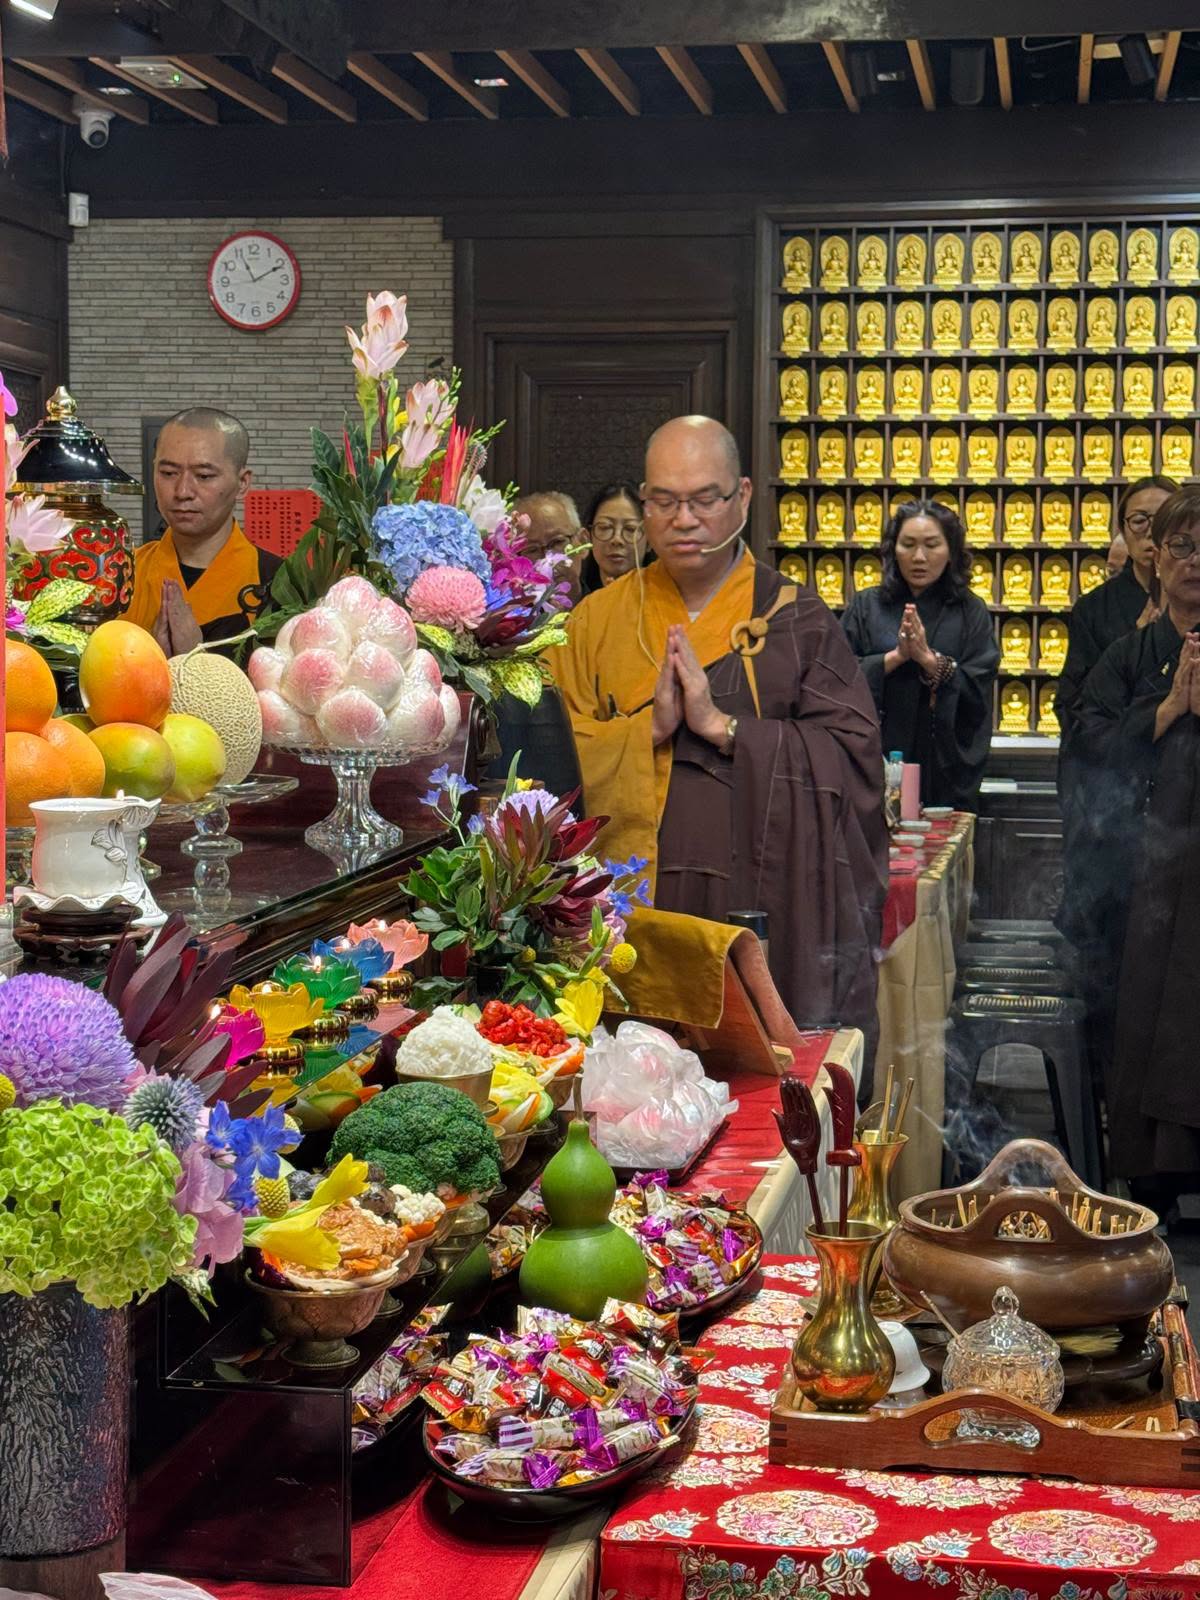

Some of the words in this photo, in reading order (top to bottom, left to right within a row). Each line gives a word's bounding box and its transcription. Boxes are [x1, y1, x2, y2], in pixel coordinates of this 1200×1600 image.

[248, 244, 260, 255] 12
[223, 260, 236, 272] 10
[221, 276, 230, 288] 9
[280, 274, 290, 285] 3
[226, 291, 235, 303] 8
[276, 290, 285, 300] 4
[238, 303, 246, 314] 7
[251, 306, 261, 317] 6
[266, 302, 276, 313] 5
